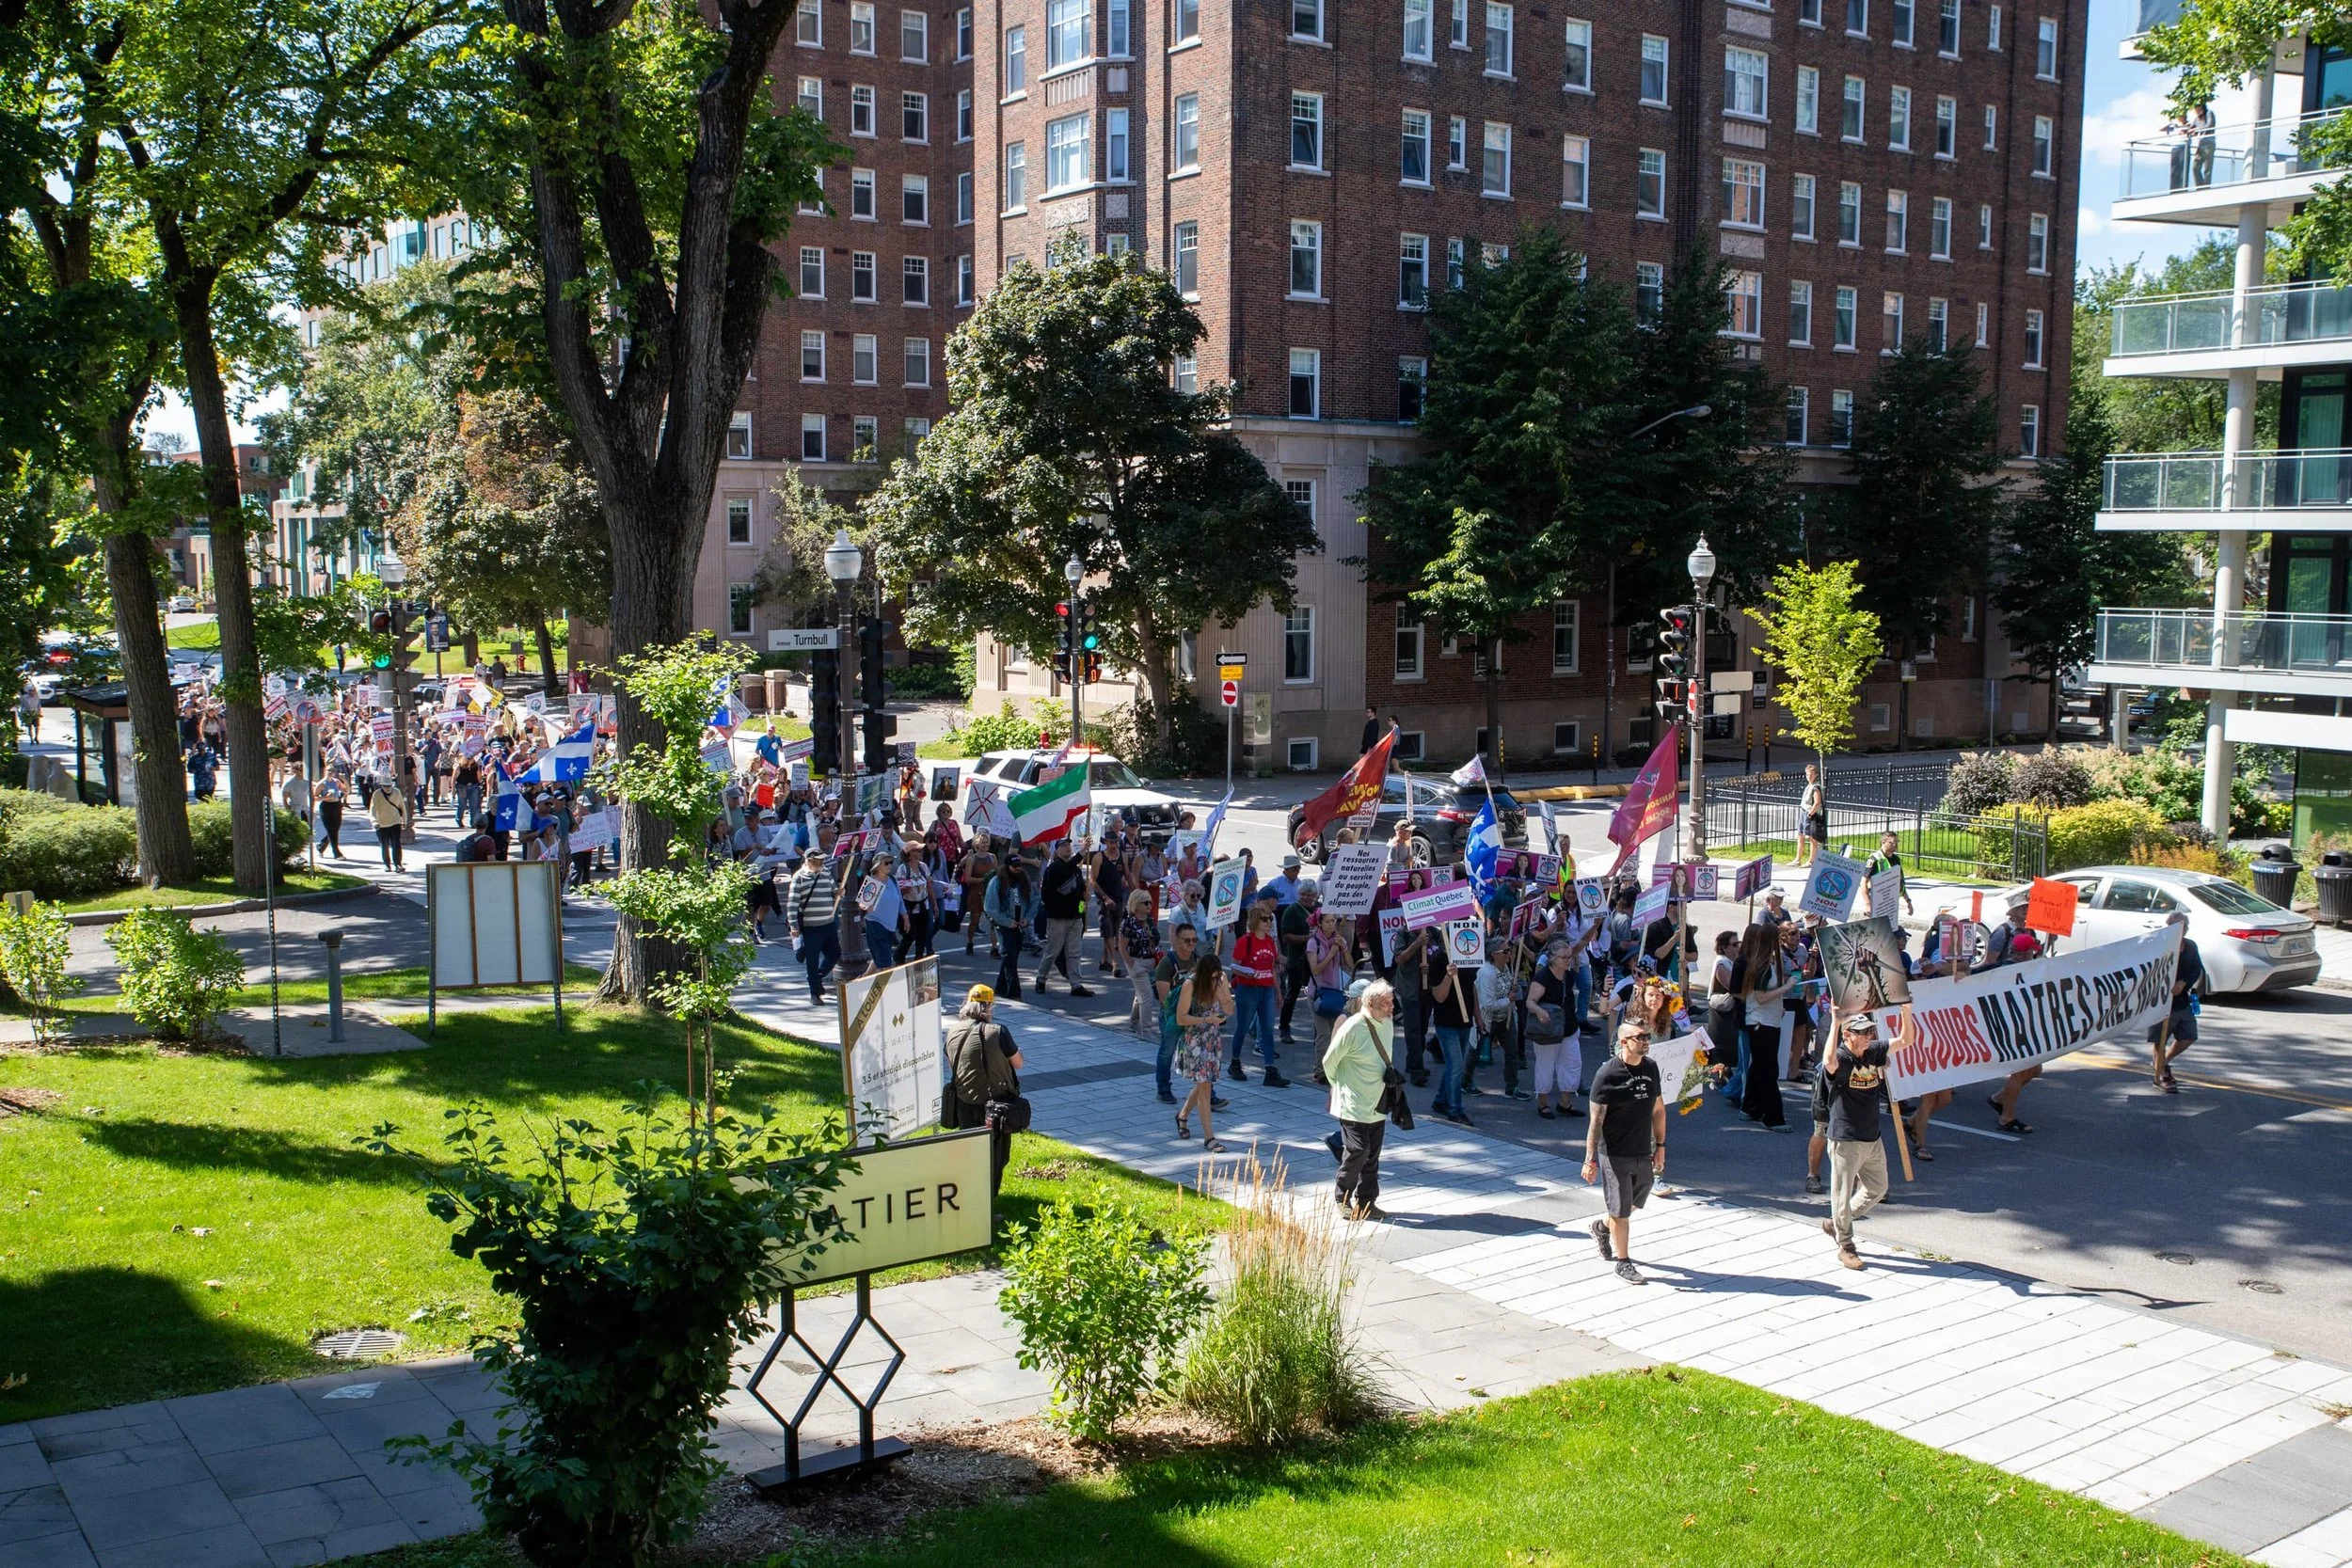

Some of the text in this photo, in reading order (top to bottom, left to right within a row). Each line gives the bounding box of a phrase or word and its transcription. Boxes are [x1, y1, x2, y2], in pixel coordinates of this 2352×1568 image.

[794, 634, 828, 646] Turnbull
[1345, 881, 1371, 891] peuple,
[1337, 892, 1350, 900] pas
[1407, 891, 1464, 911] Climat Québec
[1816, 896, 1838, 909] NON
[1327, 898, 1368, 908] oligarques!
[1217, 906, 1232, 915] NON
[1382, 916, 1406, 928] NON
[856, 981, 883, 1030] À LOUER
[1885, 950, 2175, 1078] TOUJOURS MAÎTRES CHEZ NOUS
[891, 1030, 917, 1047] WATIER
[862, 1050, 935, 1085] 3.5 et studios disponibles
[803, 1181, 961, 1232] ATIER
